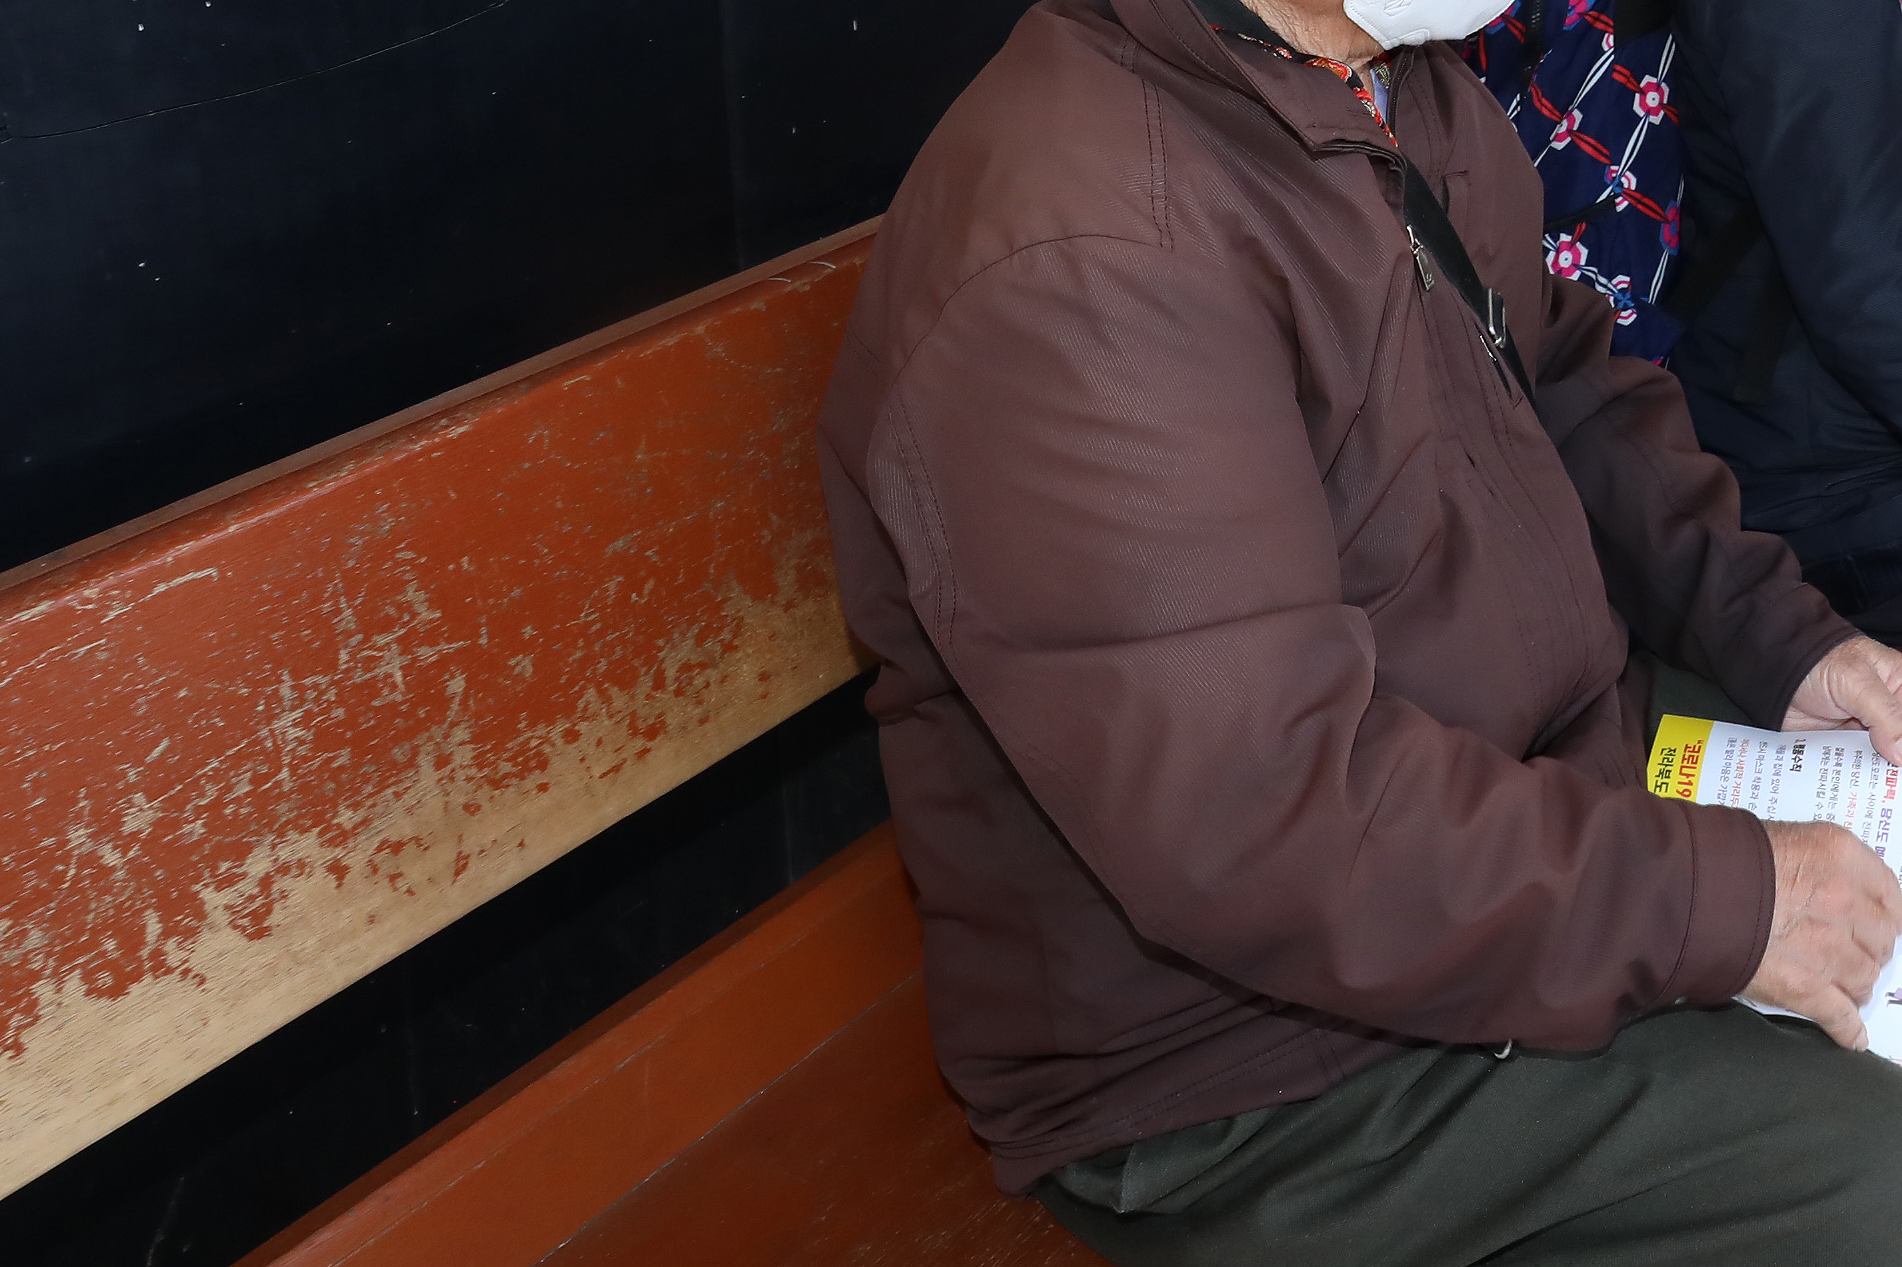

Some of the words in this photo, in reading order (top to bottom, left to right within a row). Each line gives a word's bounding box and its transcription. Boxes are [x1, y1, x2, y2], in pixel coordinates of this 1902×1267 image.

[1653, 747, 1678, 794] 전라북도
[1719, 762, 1732, 783] 마음은
[1733, 759, 1745, 780] 사회적
[1754, 754, 1766, 774] 마스크
[1772, 763, 1783, 777] 집에
[1749, 776, 1762, 800] 착용과
[1769, 778, 1780, 794] 있어
[1815, 768, 1829, 799] 전파시킬
[1827, 769, 1842, 811] 본인에게는
[1869, 767, 1880, 790] 모르는
[1814, 802, 1824, 811] 수
[1844, 792, 1858, 818] 가족과
[1864, 793, 1876, 819] 사이에
[1876, 807, 1893, 843] 당신도
